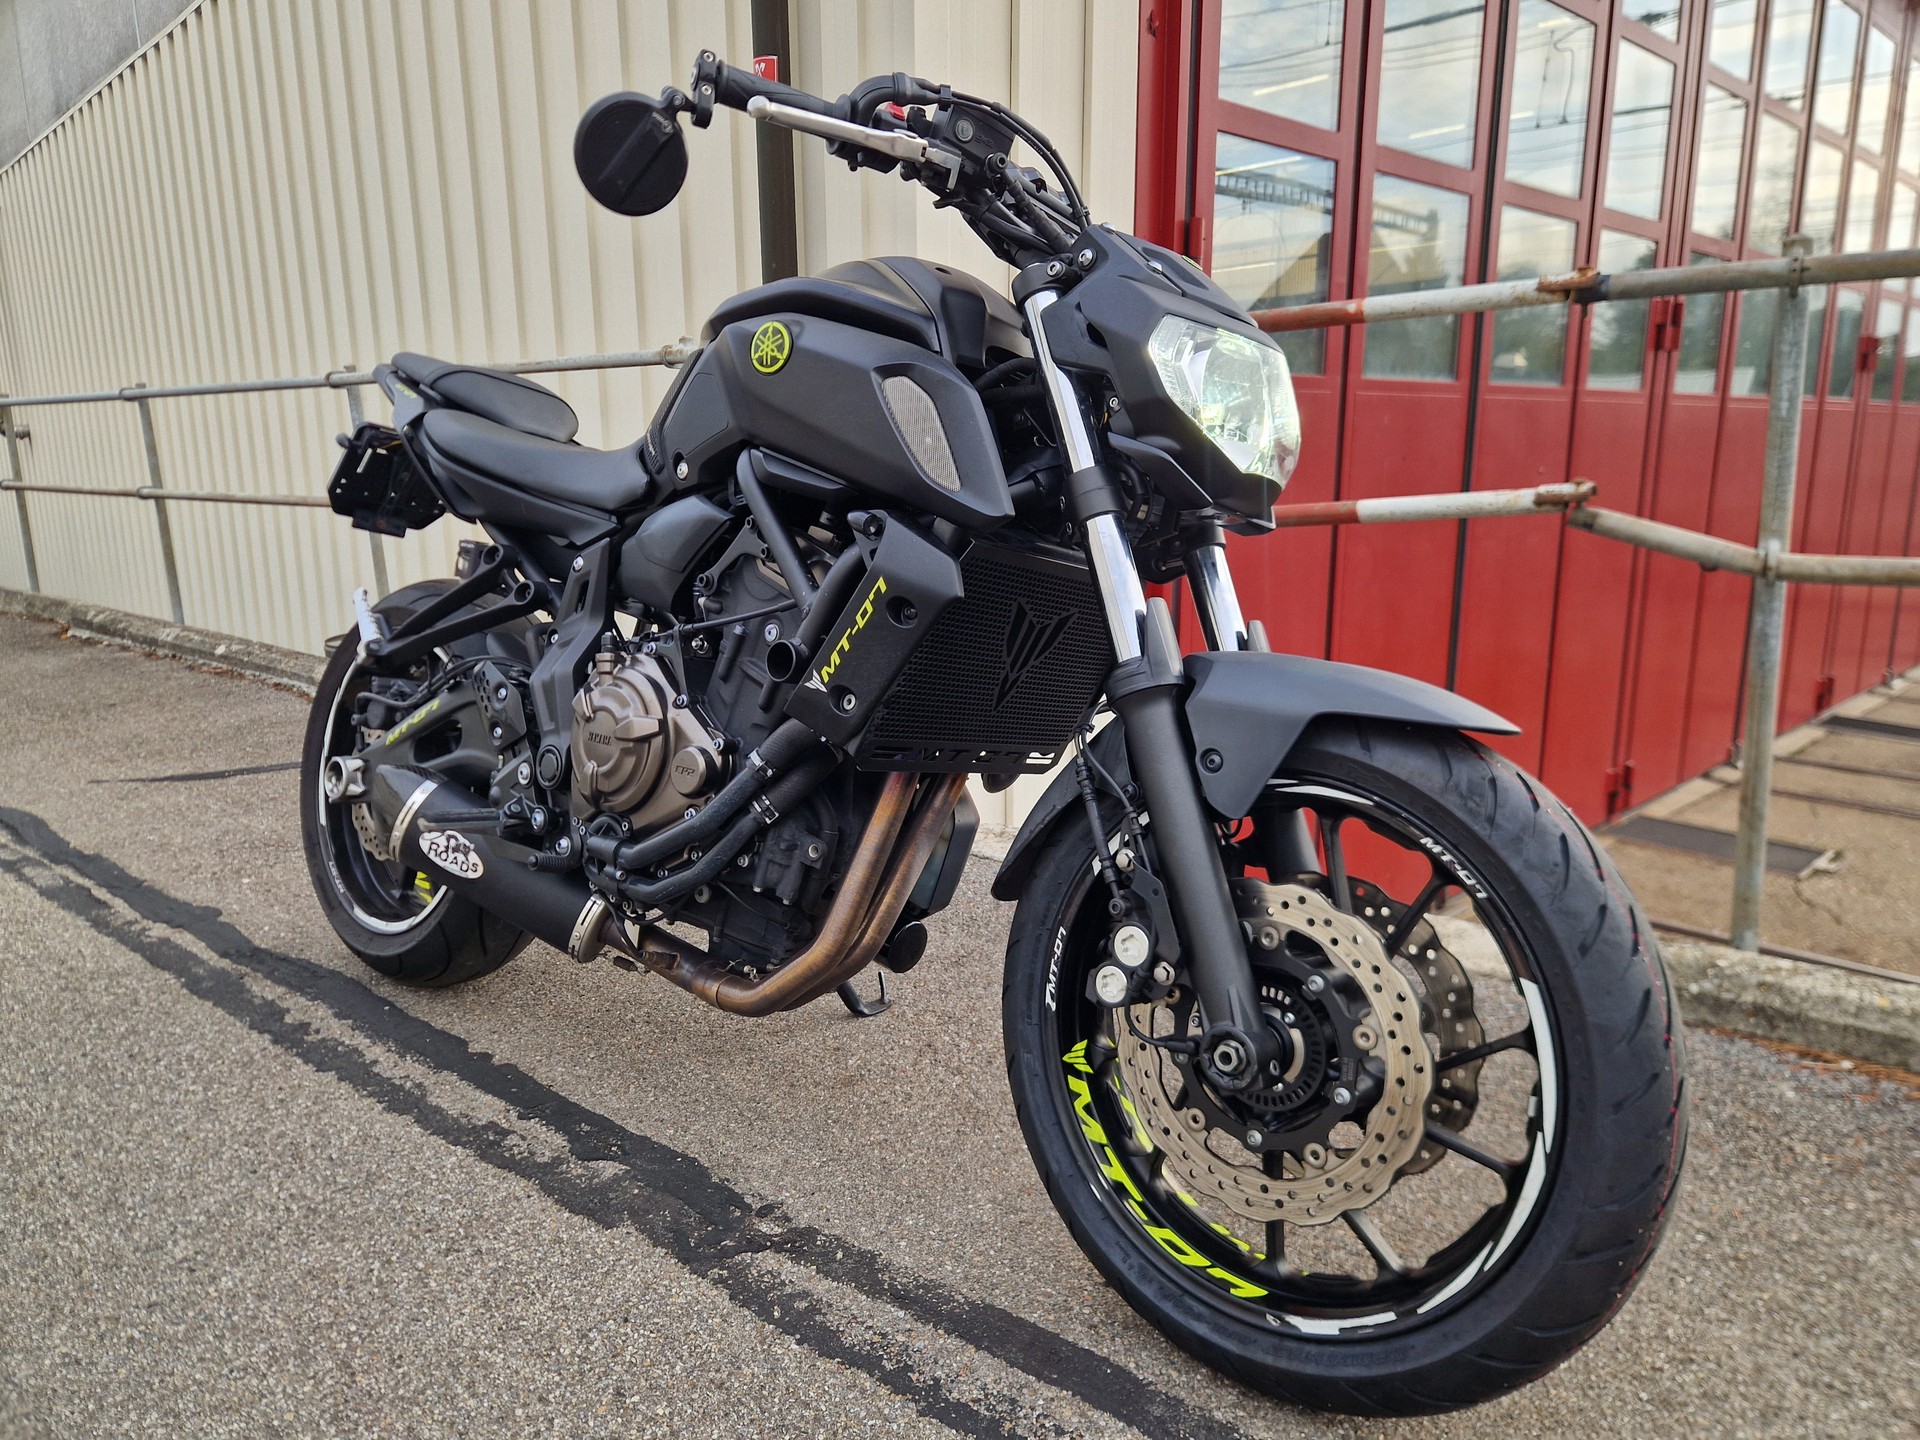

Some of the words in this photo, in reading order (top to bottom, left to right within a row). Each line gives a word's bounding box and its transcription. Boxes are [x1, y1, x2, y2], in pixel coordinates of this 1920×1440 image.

[821, 576, 887, 683] MT-07
[427, 842, 479, 873] ROADS
[1419, 837, 1488, 898] MT-07
[1047, 926, 1067, 993] MT-07
[1067, 1075, 1269, 1298] MT-07
